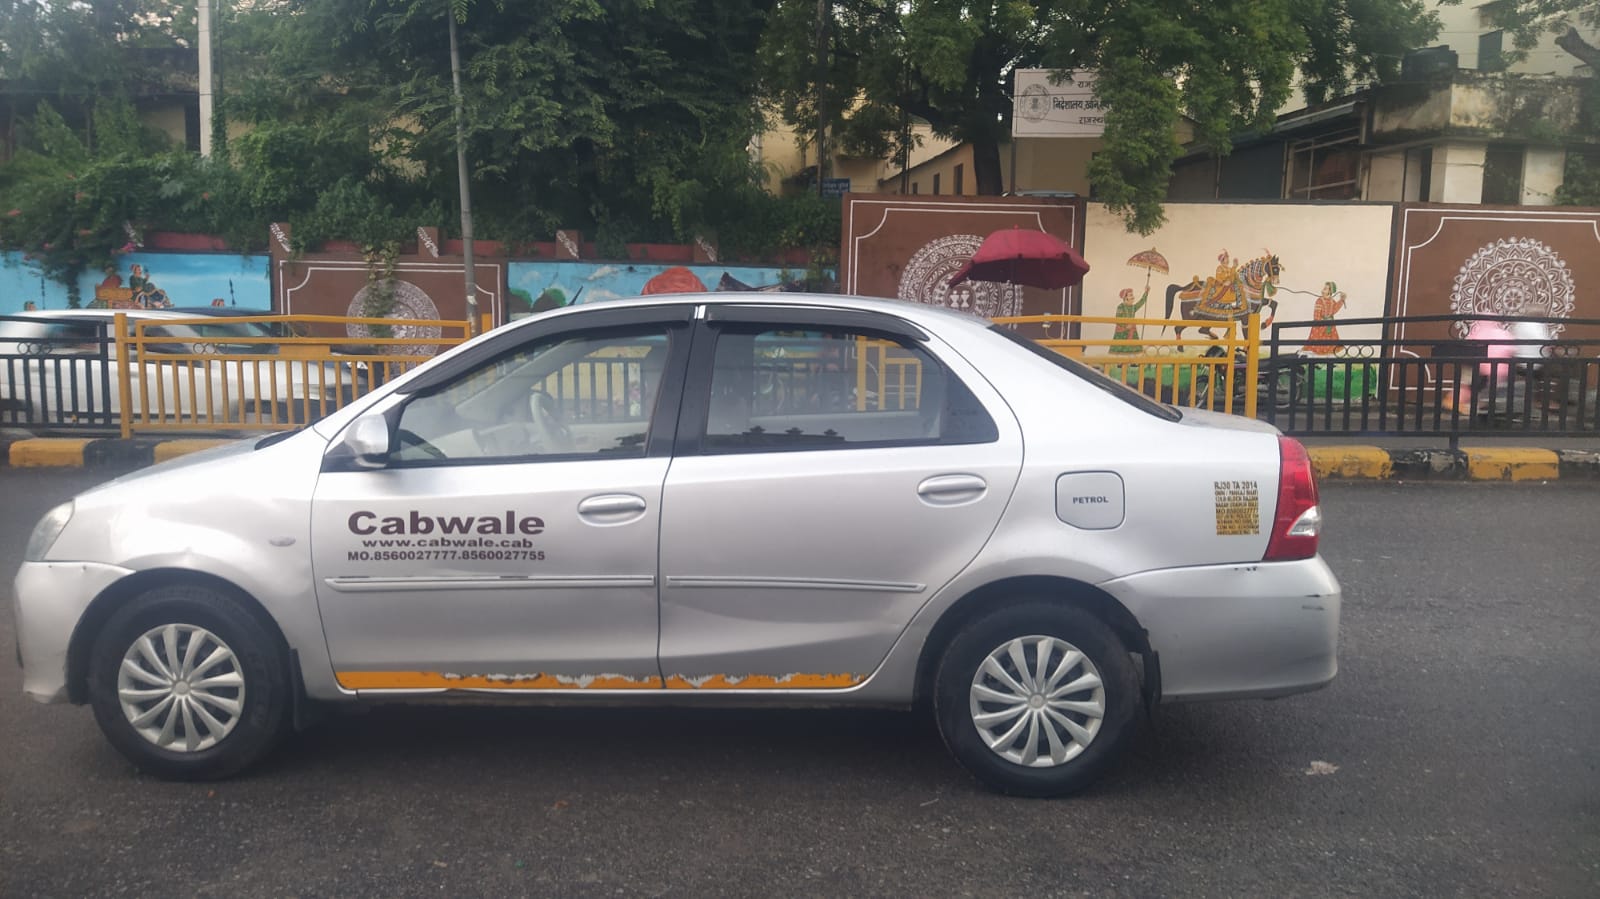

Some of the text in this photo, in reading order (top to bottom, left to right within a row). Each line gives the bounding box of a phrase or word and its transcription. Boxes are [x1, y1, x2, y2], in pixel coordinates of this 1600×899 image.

[1232, 481, 1240, 489] TA
[1241, 481, 1258, 489] 2014
[1072, 496, 1109, 504] PETROL
[347, 510, 546, 535] Cabwale
[361, 537, 534, 548] www.cabwale.cab
[347, 550, 546, 561] MO.8560027777.8560027755
